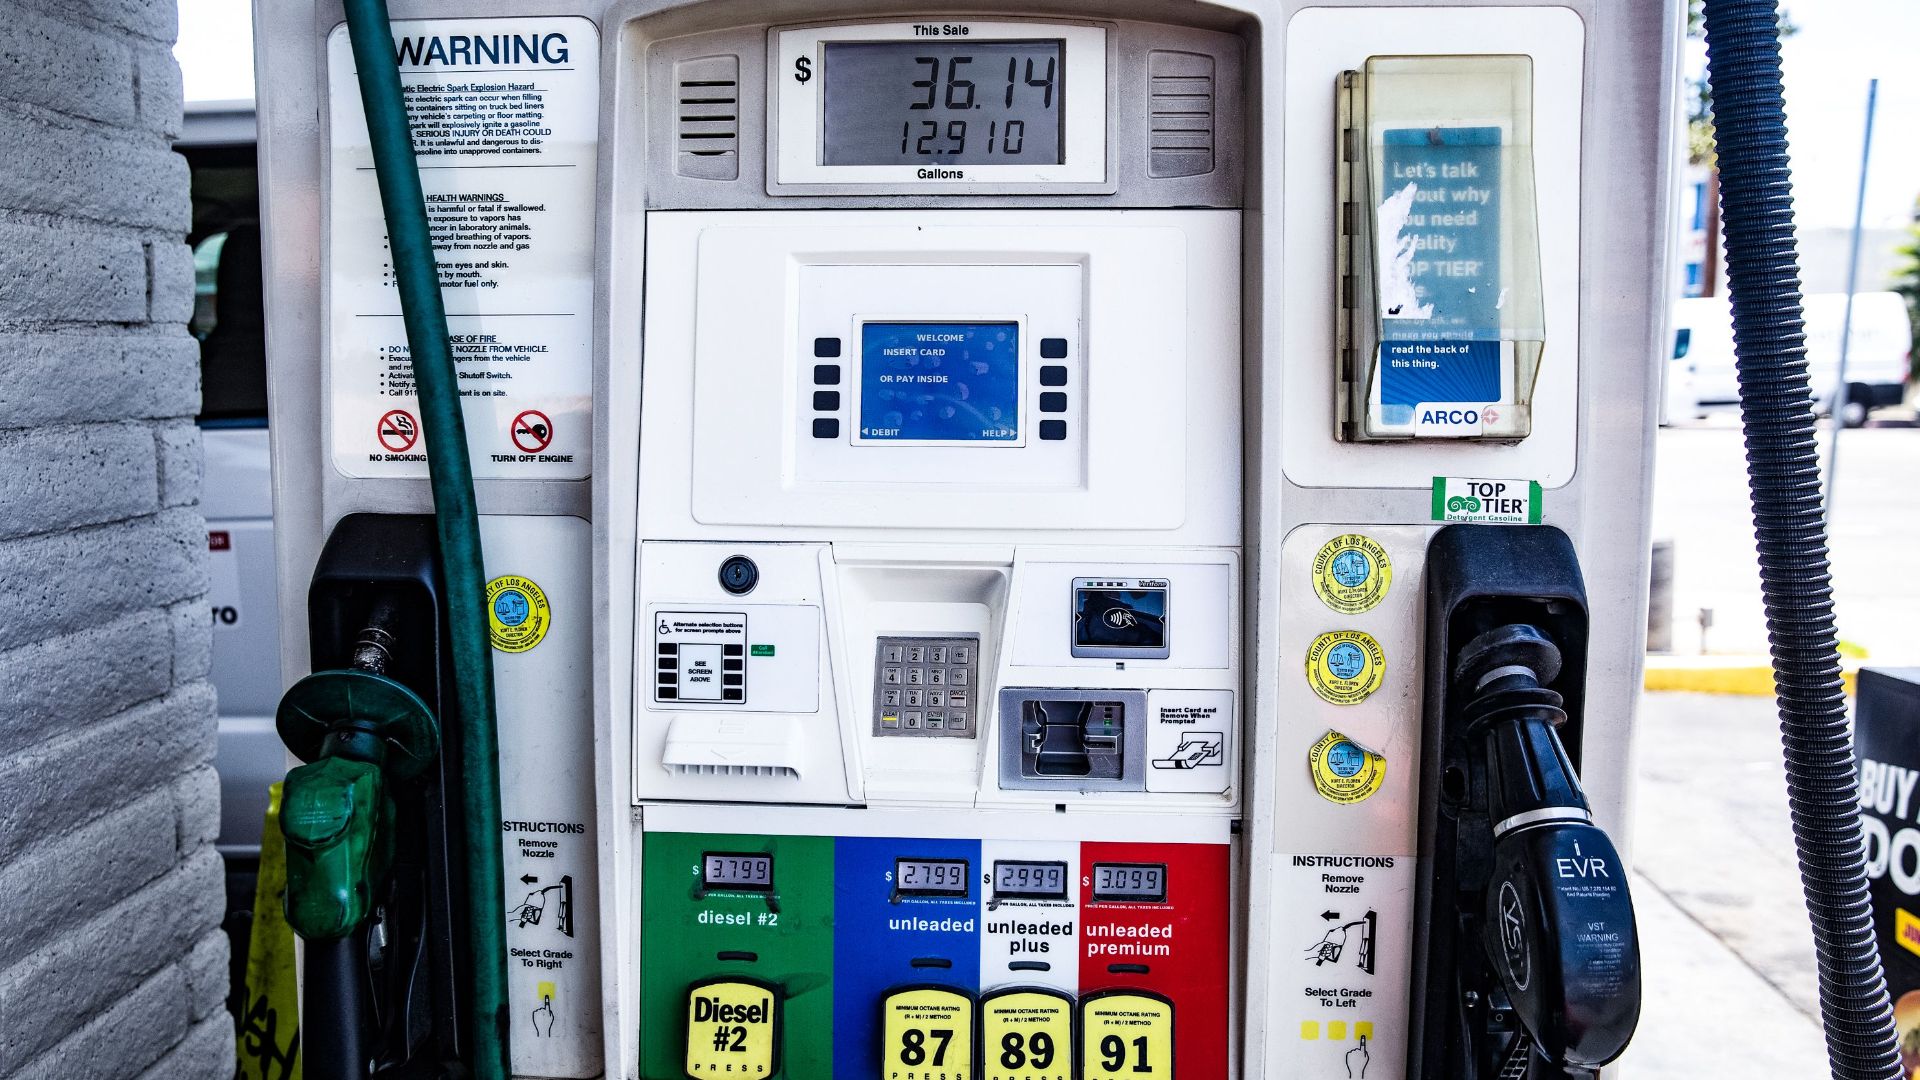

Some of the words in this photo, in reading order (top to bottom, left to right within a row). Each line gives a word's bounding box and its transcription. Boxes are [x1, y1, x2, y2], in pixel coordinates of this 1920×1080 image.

[914, 25, 940, 36] This
[943, 25, 969, 36] Sale
[393, 33, 568, 66] WARNING
[794, 56, 812, 85] $
[417, 84, 445, 92] Electric
[447, 84, 468, 93] Spark
[471, 84, 506, 92] Explosion
[910, 56, 1055, 109] 36.14
[444, 95, 463, 103] spark
[522, 94, 542, 103] filling
[453, 112, 485, 120] carpeting
[510, 120, 540, 128] gasoline
[523, 128, 551, 136] COULD
[482, 138, 519, 146] dangerous
[460, 147, 500, 156] unapproved
[917, 168, 963, 180] Gallons
[1394, 162, 1436, 178] Let's
[1442, 162, 1478, 178] talk
[1452, 186, 1490, 205] why
[478, 204, 494, 212] fatal
[1432, 211, 1477, 226] need
[459, 224, 497, 232] laboratory
[456, 233, 491, 241] breathing
[481, 280, 499, 288] only.
[917, 334, 964, 342] WELCOME
[1392, 345, 1413, 353] read
[1416, 345, 1431, 353] the
[1434, 345, 1457, 353] back
[1460, 345, 1469, 353] of
[1412, 360, 1440, 369] thing.
[388, 381, 410, 389] Notify
[1422, 410, 1478, 425] ARCO
[872, 428, 900, 436] DEBIT
[369, 454, 383, 462] NO
[385, 454, 427, 462] SMOKING
[491, 454, 516, 462] TURN
[518, 454, 536, 462] OFF
[538, 455, 573, 463] ENGINE
[1467, 482, 1506, 497] TOP
[1447, 514, 1486, 522] Detergent
[1488, 514, 1523, 522] Gasoline
[1315, 546, 1334, 575] COUNTY
[1334, 540, 1343, 549] OF
[1346, 538, 1361, 546] LOS
[1362, 540, 1387, 569] ANGELES
[495, 580, 504, 589] OF
[506, 578, 520, 586] LOS
[521, 582, 546, 609] ANGELES
[212, 606, 238, 625] ro
[1310, 636, 1332, 662] COUNTY
[1346, 632, 1361, 640] LOS
[1361, 636, 1382, 666] ANGELES
[910, 696, 916, 704] 8
[1312, 738, 1330, 762] COUNTY
[1860, 758, 1919, 820] BUY
[503, 821, 585, 834] STRUCTIONS
[518, 838, 558, 848] Remove
[522, 850, 555, 858] Nozzle
[1292, 856, 1394, 868] INSTRUCTIONS
[1557, 858, 1609, 878] EVR
[692, 865, 700, 875] $
[713, 860, 767, 879] 3.799
[886, 871, 893, 882] $
[904, 866, 960, 885] 2.799
[1003, 868, 1059, 887] 2.999
[1082, 876, 1090, 887] $
[1102, 870, 1157, 889] 3.099
[1322, 874, 1364, 883] Remove
[1325, 884, 1360, 893] Nozzle
[698, 910, 751, 925] diesel
[758, 912, 778, 926] #2
[890, 917, 974, 932] unleaded
[988, 920, 1073, 935] unleaded
[1086, 923, 1172, 938] unleaded
[1588, 922, 1605, 931] VST
[1577, 933, 1619, 942] WARNING
[1010, 938, 1050, 955] plus
[1088, 942, 1170, 957] premium
[510, 948, 540, 958] Select
[543, 950, 573, 959] Grade
[522, 959, 534, 967] To
[536, 960, 563, 970] Right
[1305, 988, 1337, 997] Select
[1340, 988, 1372, 998] Grade
[1320, 999, 1333, 1007] To
[1336, 999, 1356, 1008] Left
[694, 996, 769, 1024] Diesel
[714, 1026, 747, 1052] #2
[900, 1029, 954, 1066] 87
[1001, 1032, 1054, 1070] 89
[1101, 1035, 1152, 1073] 91
[694, 1063, 763, 1073] PRESS
